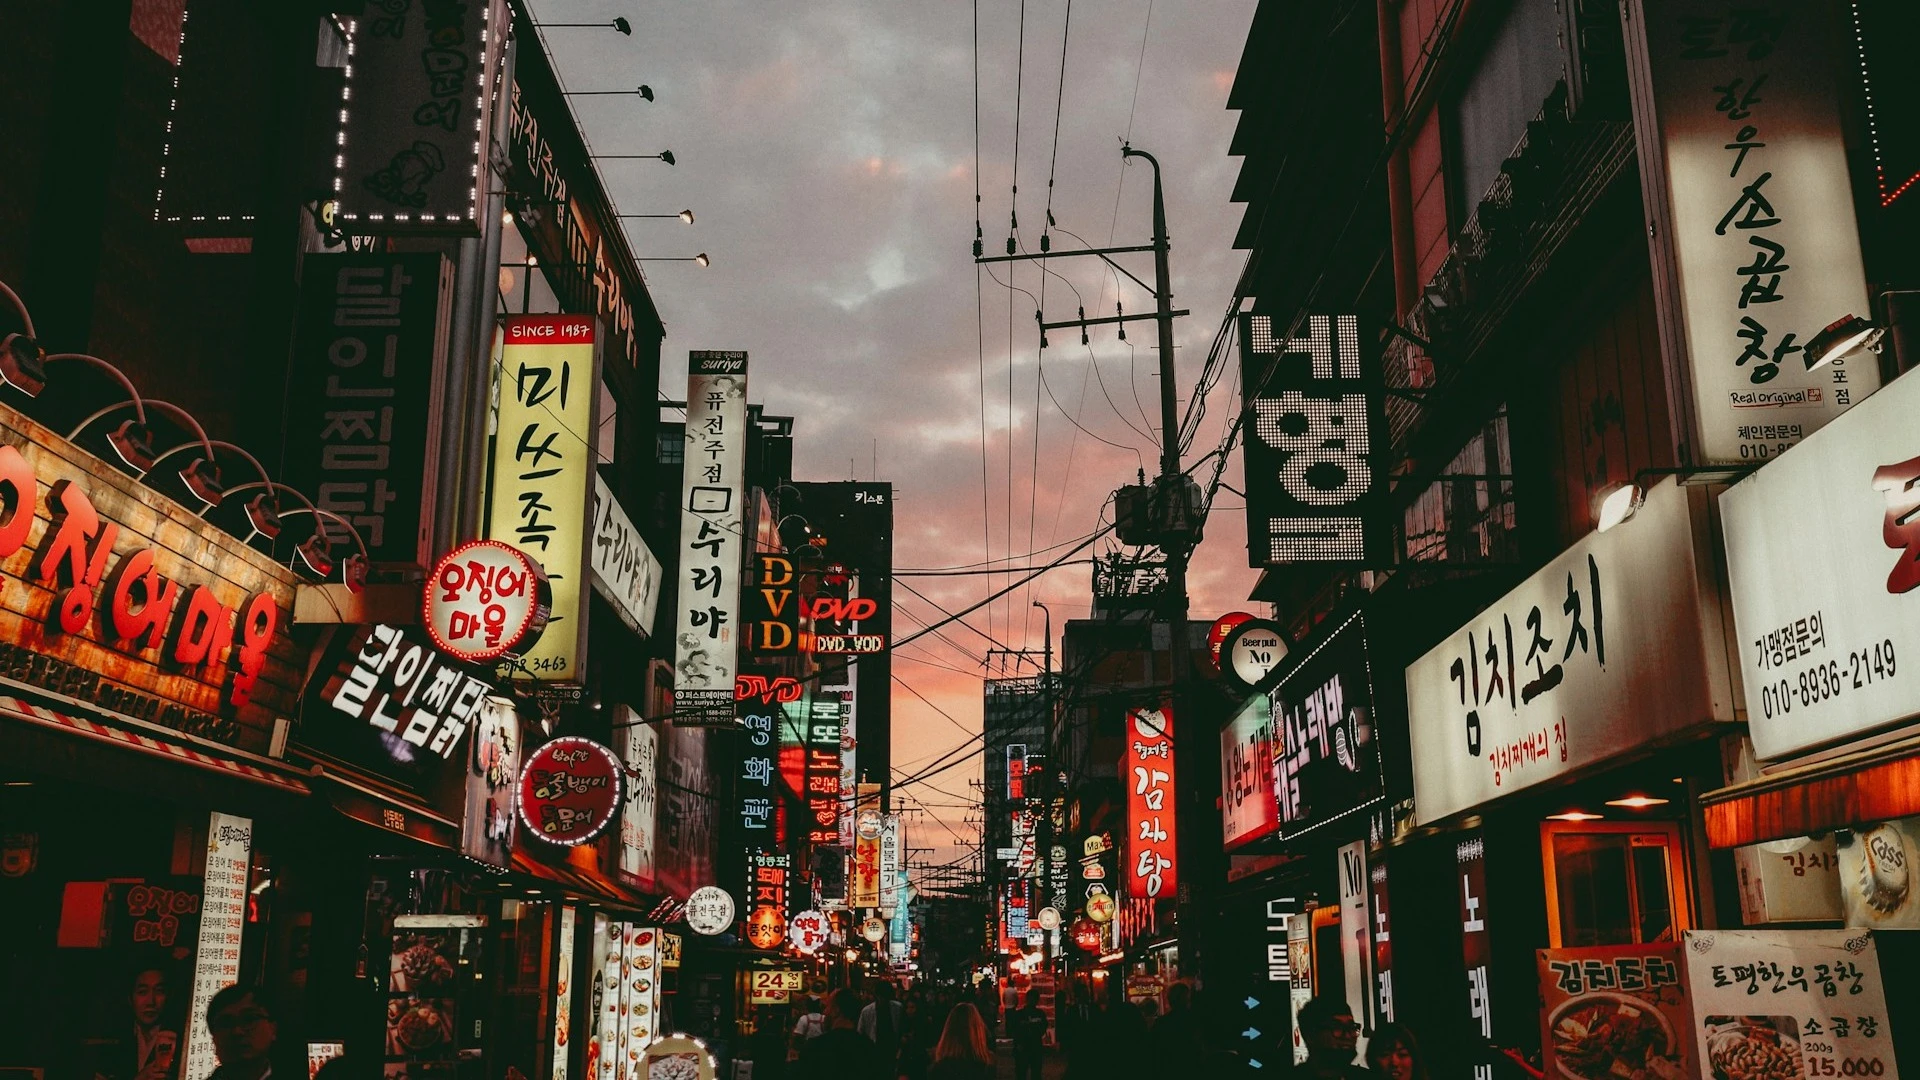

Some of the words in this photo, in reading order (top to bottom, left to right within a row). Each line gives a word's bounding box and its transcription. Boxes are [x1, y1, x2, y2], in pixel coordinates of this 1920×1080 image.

[512, 325, 555, 337] SINCE
[560, 325, 591, 338] 1987
[700, 357, 744, 373] suriya
[315, 263, 413, 547] 달인찜닭
[1731, 392, 1756, 404] Real
[702, 391, 726, 484] 퓨전주점
[1738, 425, 1802, 439] 체인점문의
[597, 498, 640, 600] 수리야
[439, 560, 527, 605] 오징어
[690, 520, 728, 639] 수리야
[760, 556, 784, 650] DVD
[810, 597, 878, 621] DVD
[448, 604, 506, 647] 마을
[1755, 611, 1826, 671] 가맹점문의
[1242, 637, 1261, 647] Beer
[1261, 638, 1277, 648] pub
[1249, 650, 1271, 664] No
[1450, 553, 1606, 757] 김치조치
[533, 655, 567, 672] 3463
[1762, 639, 1897, 720] 010-8936-2149
[736, 675, 803, 705] DVD
[1133, 741, 1169, 760] 형제들
[1490, 727, 1549, 786] 김치찌개의
[1554, 716, 1567, 762] 집
[1134, 766, 1172, 898] 감자탕
[755, 855, 786, 867] 영등포
[884, 824, 896, 886] 서울불고기
[1870, 836, 1905, 868] Cass
[688, 903, 728, 918] 퓨전주점
[758, 972, 784, 988] 24
[1550, 956, 1678, 995] 김치조치
[1711, 962, 1809, 995] 토평한우
[1814, 961, 1865, 997] 곱창
[1804, 1042, 1834, 1054] 200g
[1807, 1056, 1885, 1079] 15,000
